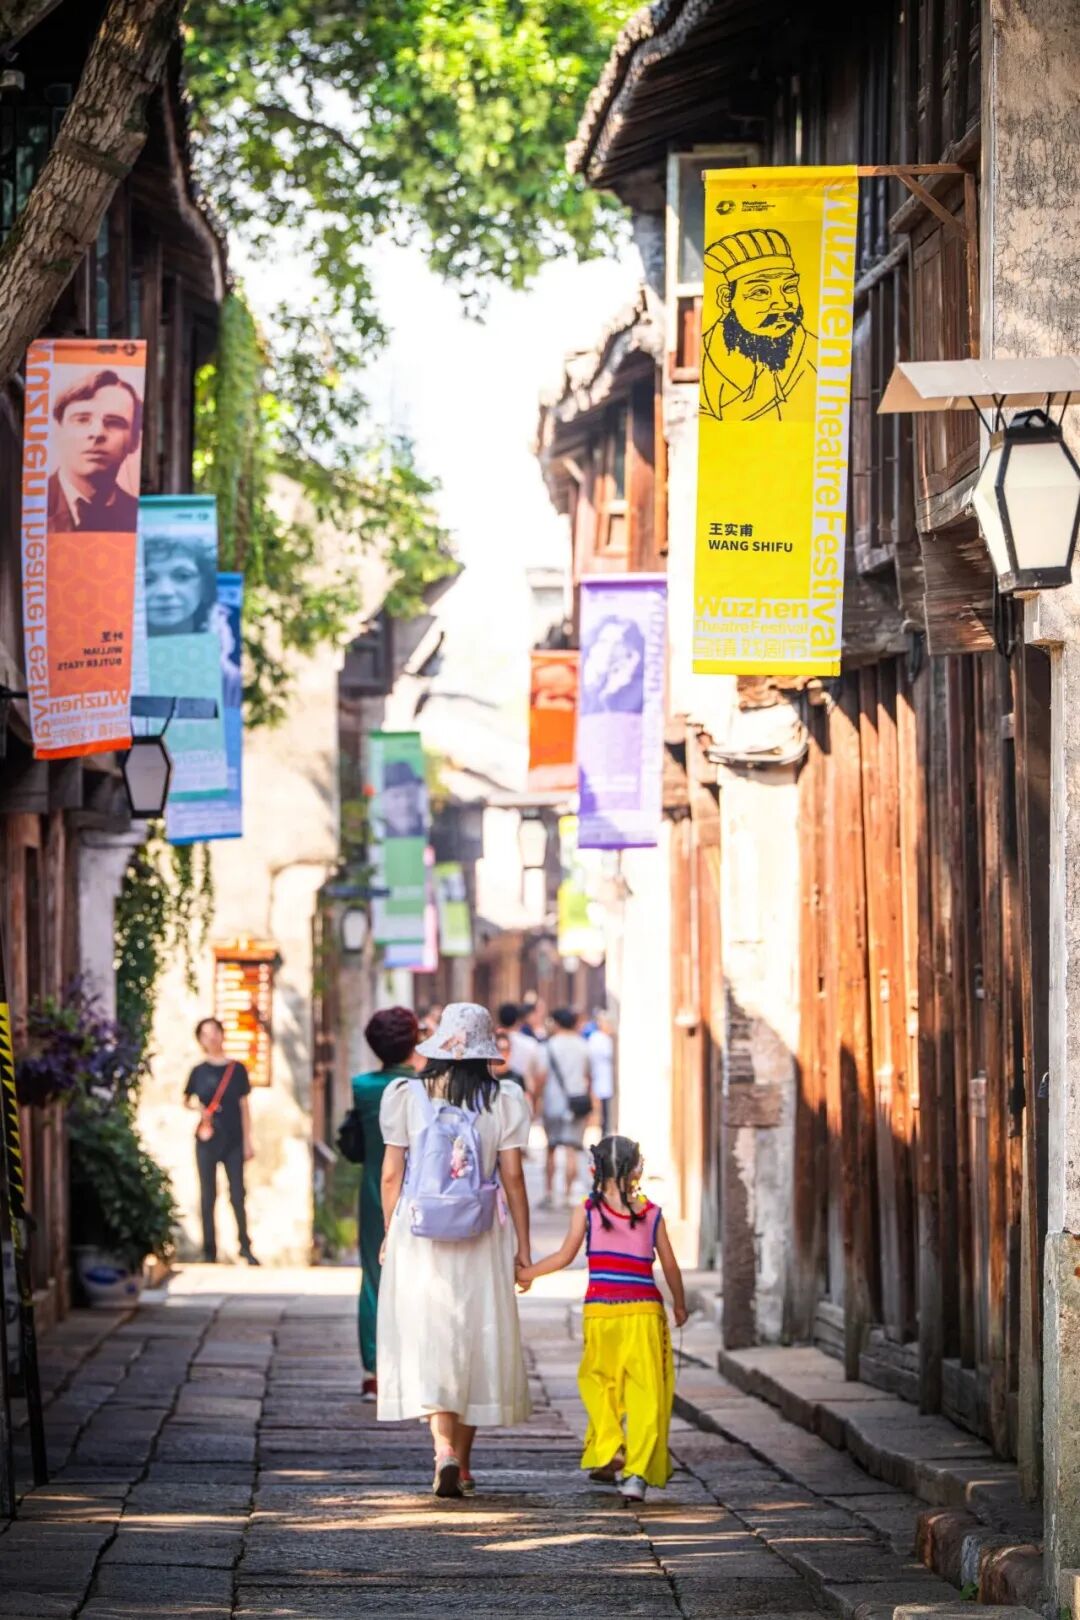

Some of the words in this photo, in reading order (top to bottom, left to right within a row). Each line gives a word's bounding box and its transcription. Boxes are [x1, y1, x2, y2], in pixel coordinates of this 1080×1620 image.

[816, 373, 851, 506] Theatre
[709, 523, 753, 537] 王实甫
[708, 540, 749, 551] WANG
[752, 541, 793, 553] SHIFU
[811, 511, 847, 657] Festival
[694, 596, 808, 619] Wuzhen
